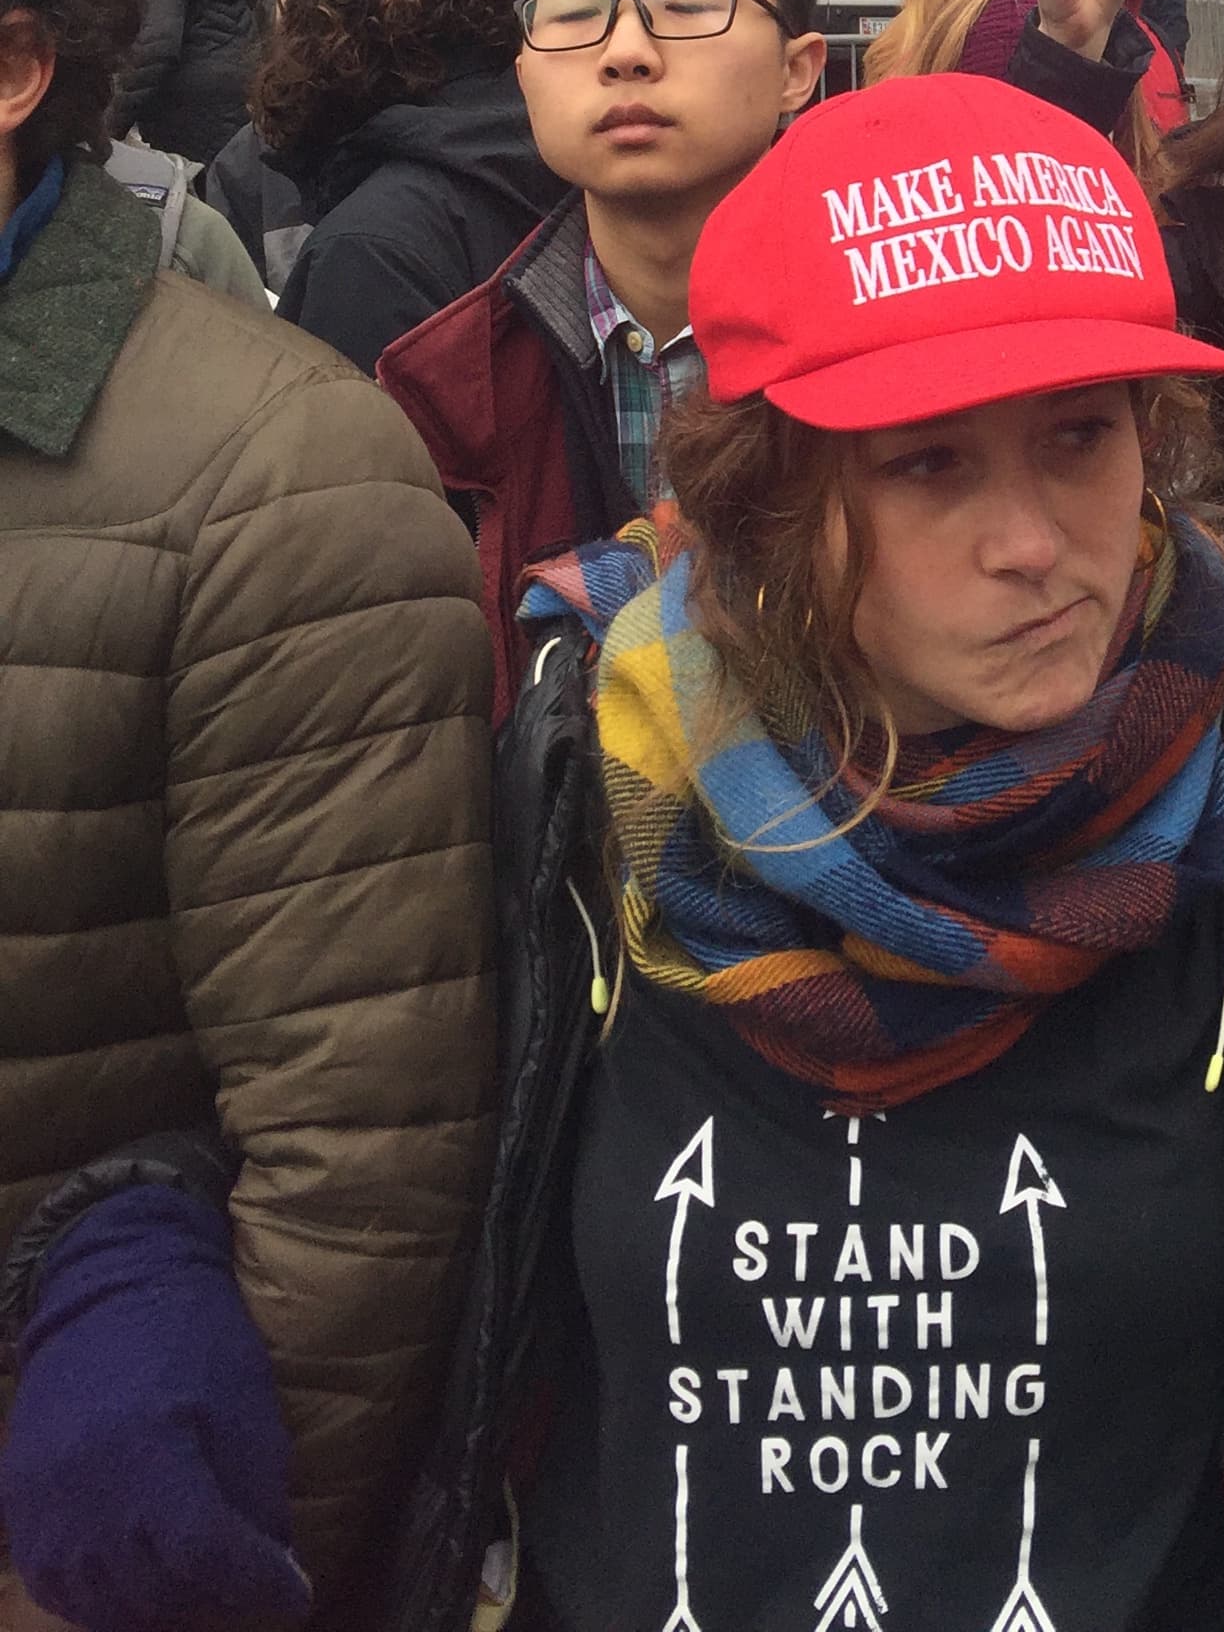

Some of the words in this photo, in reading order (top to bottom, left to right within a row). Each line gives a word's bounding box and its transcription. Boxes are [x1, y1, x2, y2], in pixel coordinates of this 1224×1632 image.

[822, 159, 964, 244] MAKE
[973, 152, 1133, 218] AMERICA
[844, 215, 1033, 306] MEXICO
[1046, 214, 1144, 280] AGAIN
[732, 1220, 980, 1282] STAND
[761, 1291, 953, 1351] WITH
[668, 1363, 1045, 1424] STANDING
[760, 1431, 950, 1494] ROCK
